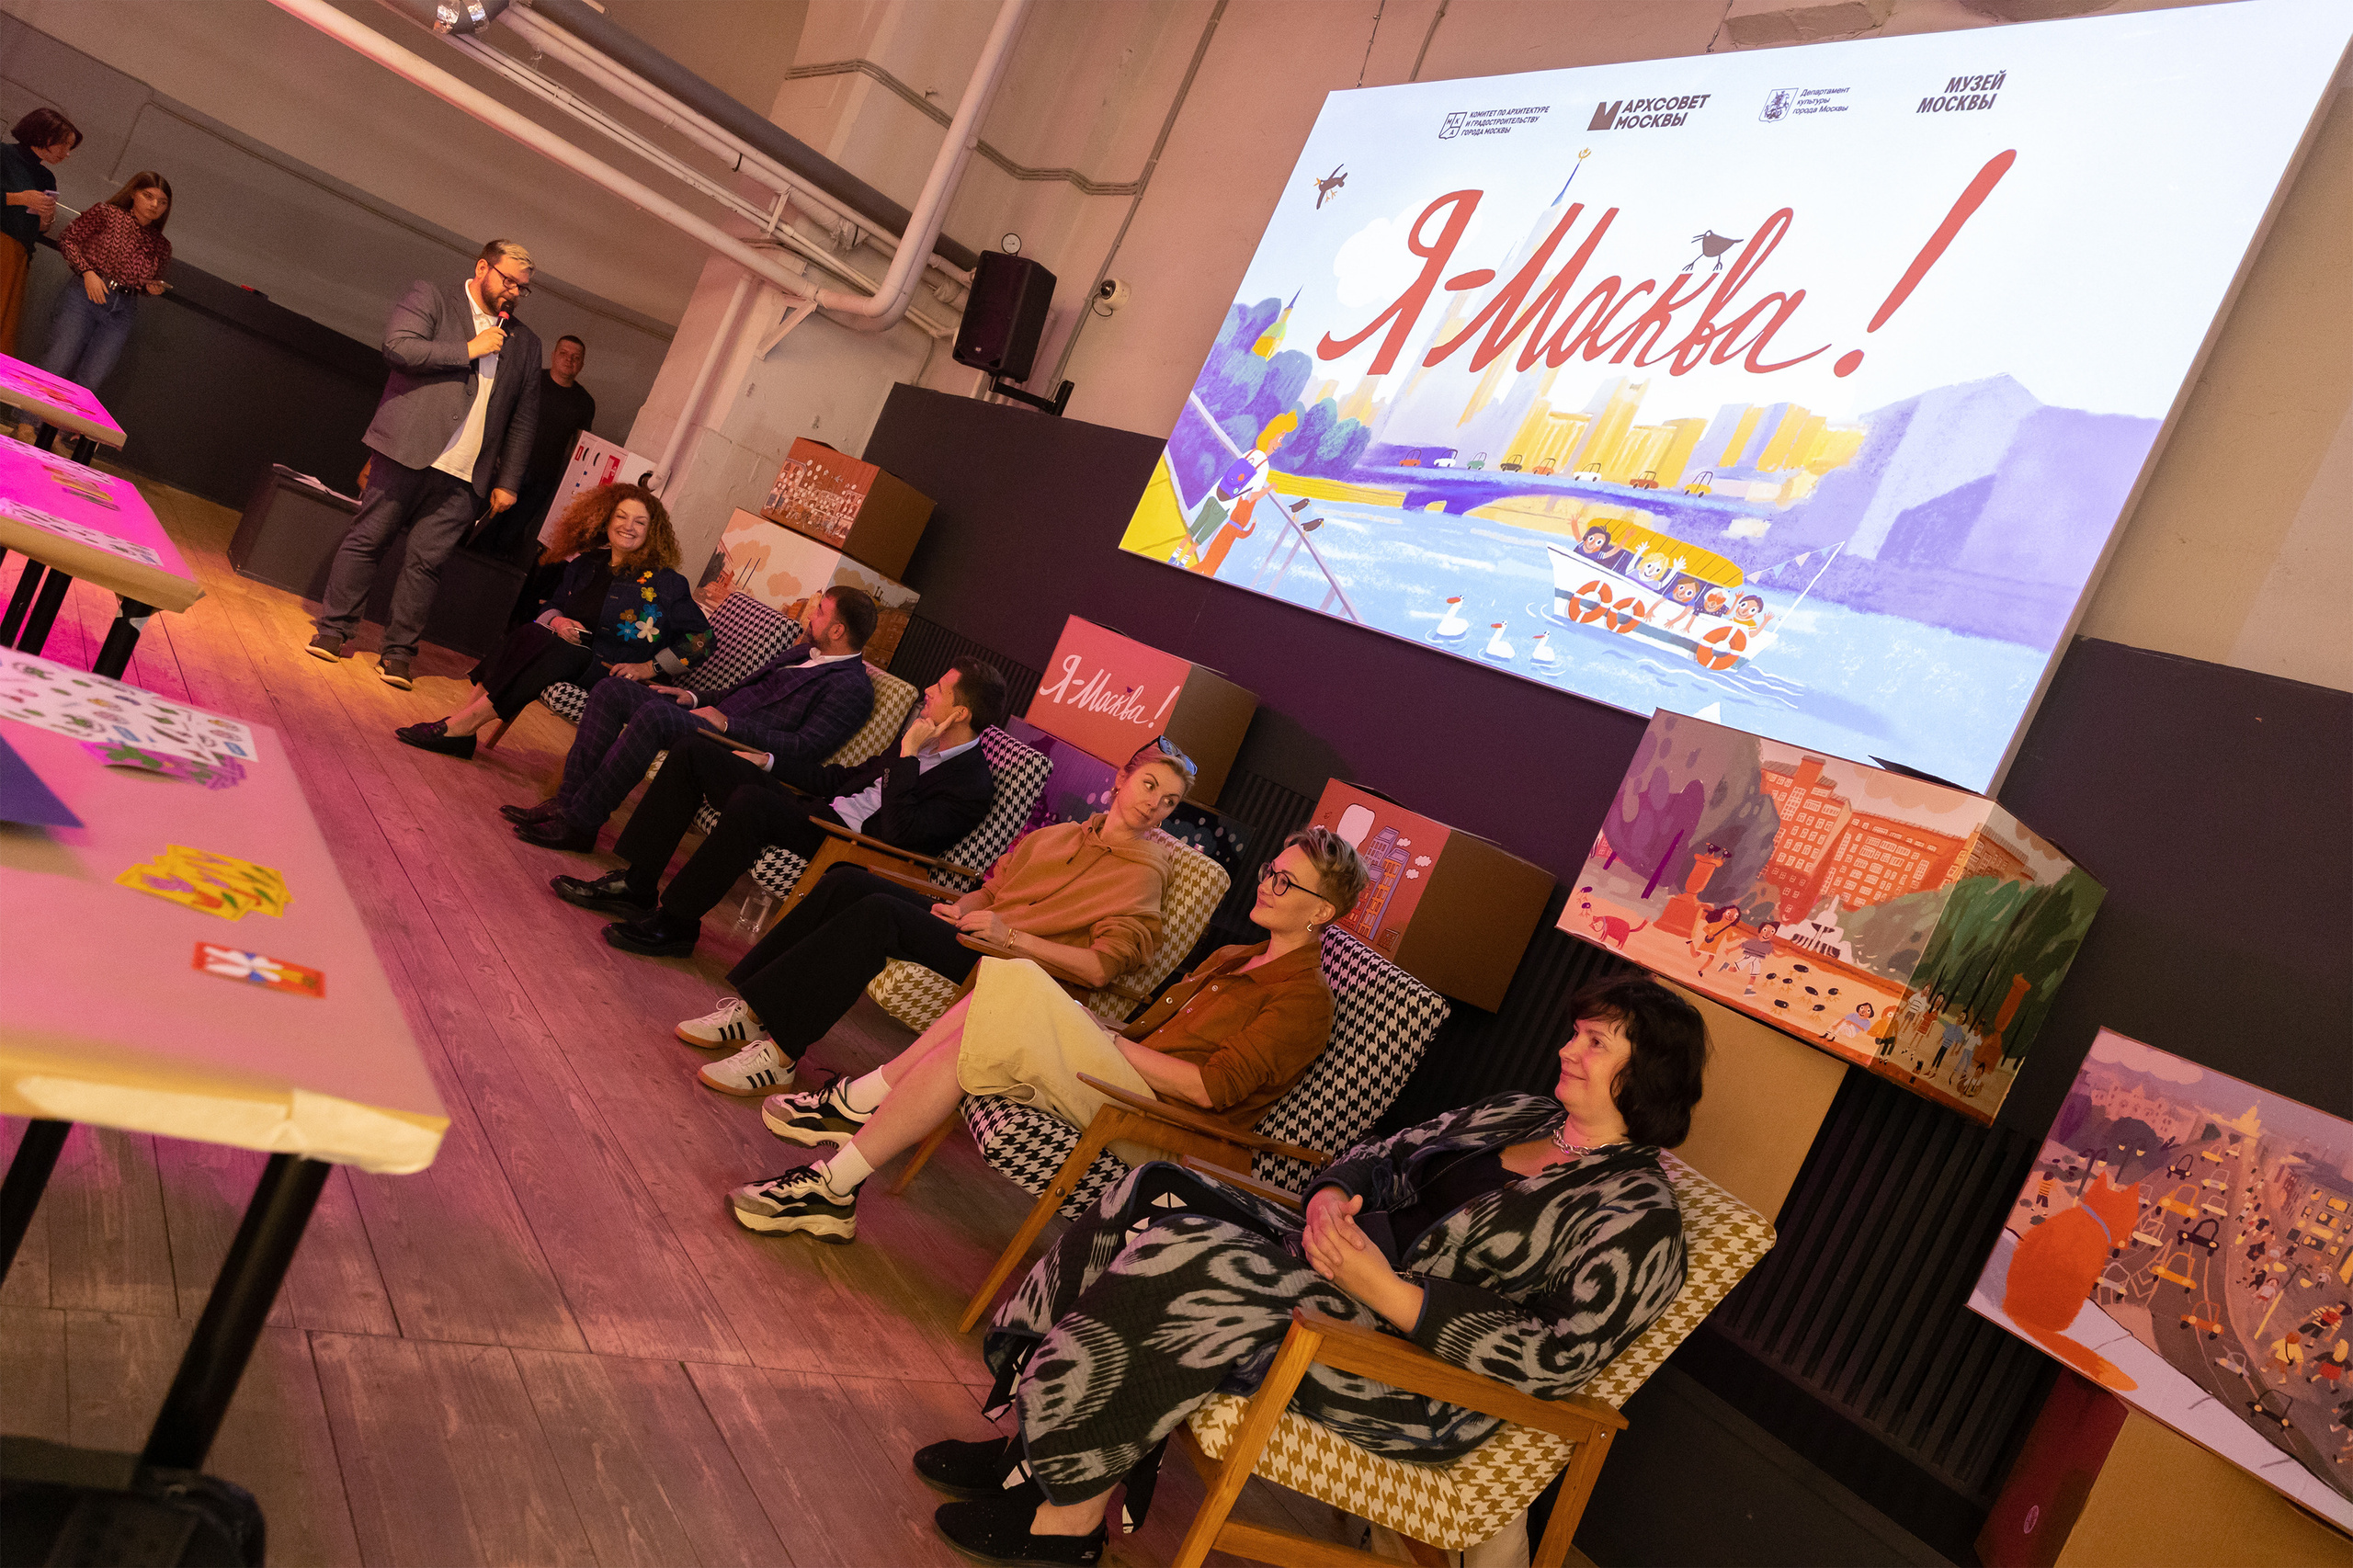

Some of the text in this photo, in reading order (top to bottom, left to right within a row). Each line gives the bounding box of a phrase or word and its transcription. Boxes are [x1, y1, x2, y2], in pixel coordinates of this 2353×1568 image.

[1944, 69, 2006, 93] МУЗЕЙ
[1800, 87, 1850, 97] Департамент
[1621, 94, 1711, 113] АРХСОВЕТ
[1797, 97, 1831, 107] культуры
[1915, 93, 1997, 113] МОСКВЫ
[1469, 106, 1551, 118] КОМИТЕТ ПО АРХИТЕКТУРЕ
[1792, 107, 1818, 115] города
[1470, 116, 1540, 127] ГРАДОСТРОИТЕЛЬСТВУ
[1614, 111, 1688, 130] МОСКВЫ
